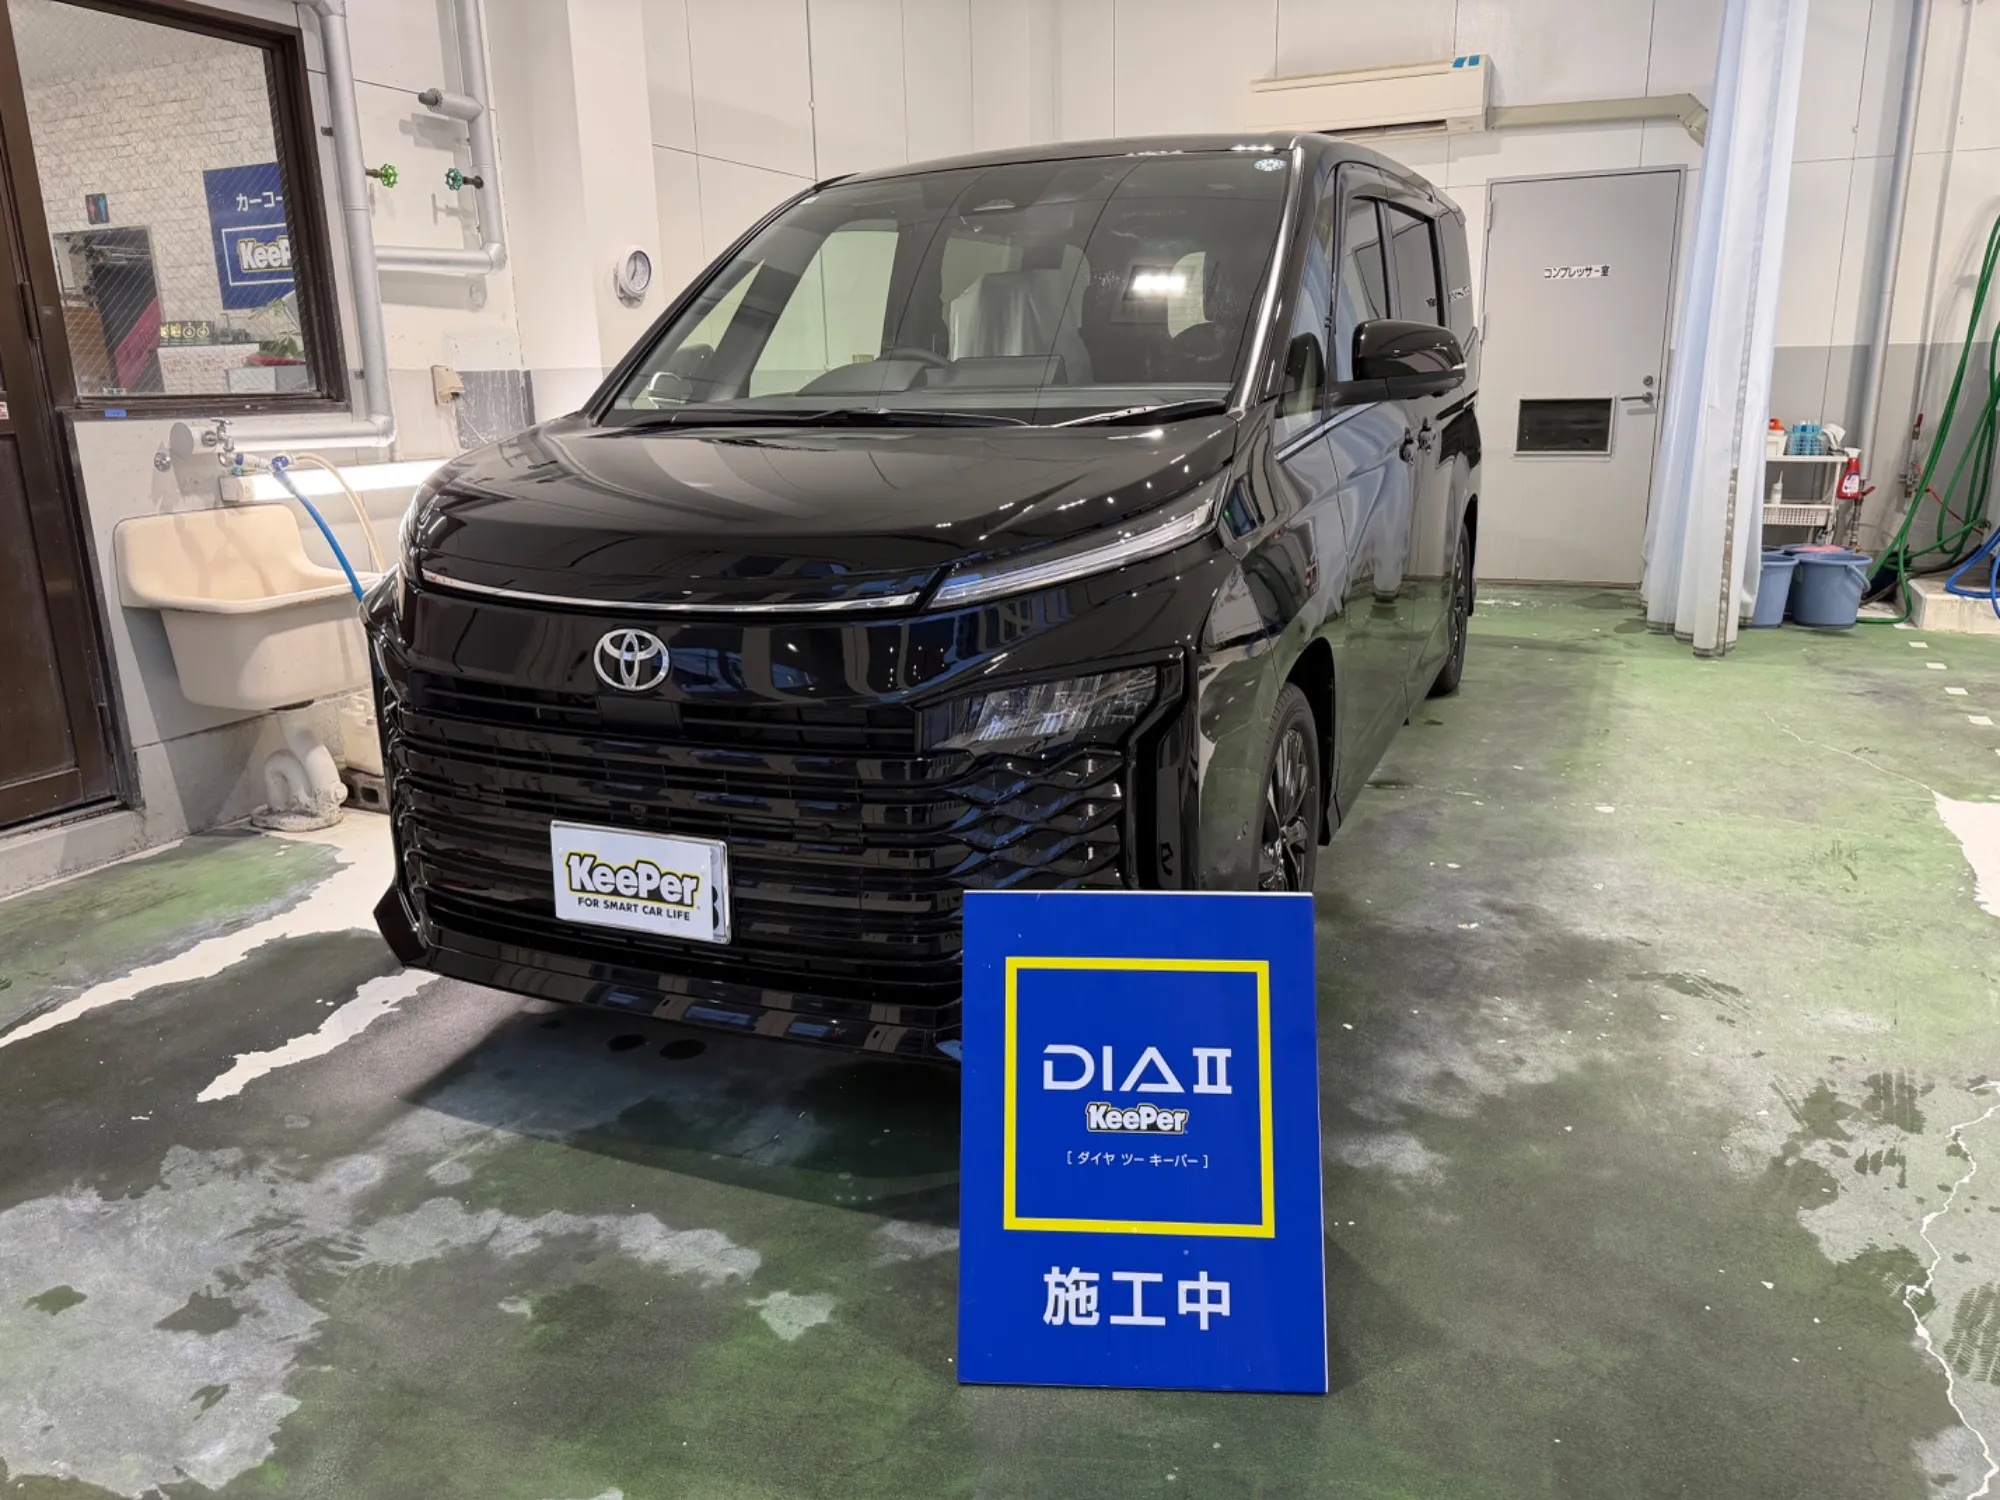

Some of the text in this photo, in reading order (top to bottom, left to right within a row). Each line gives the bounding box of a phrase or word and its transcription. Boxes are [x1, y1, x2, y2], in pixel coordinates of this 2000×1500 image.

[567, 853, 699, 907] KeePer
[578, 897, 690, 921] FOR SMART CAR LIFE
[1087, 1103, 1188, 1133] KeePer
[1043, 1266, 1231, 1331] 施工中
